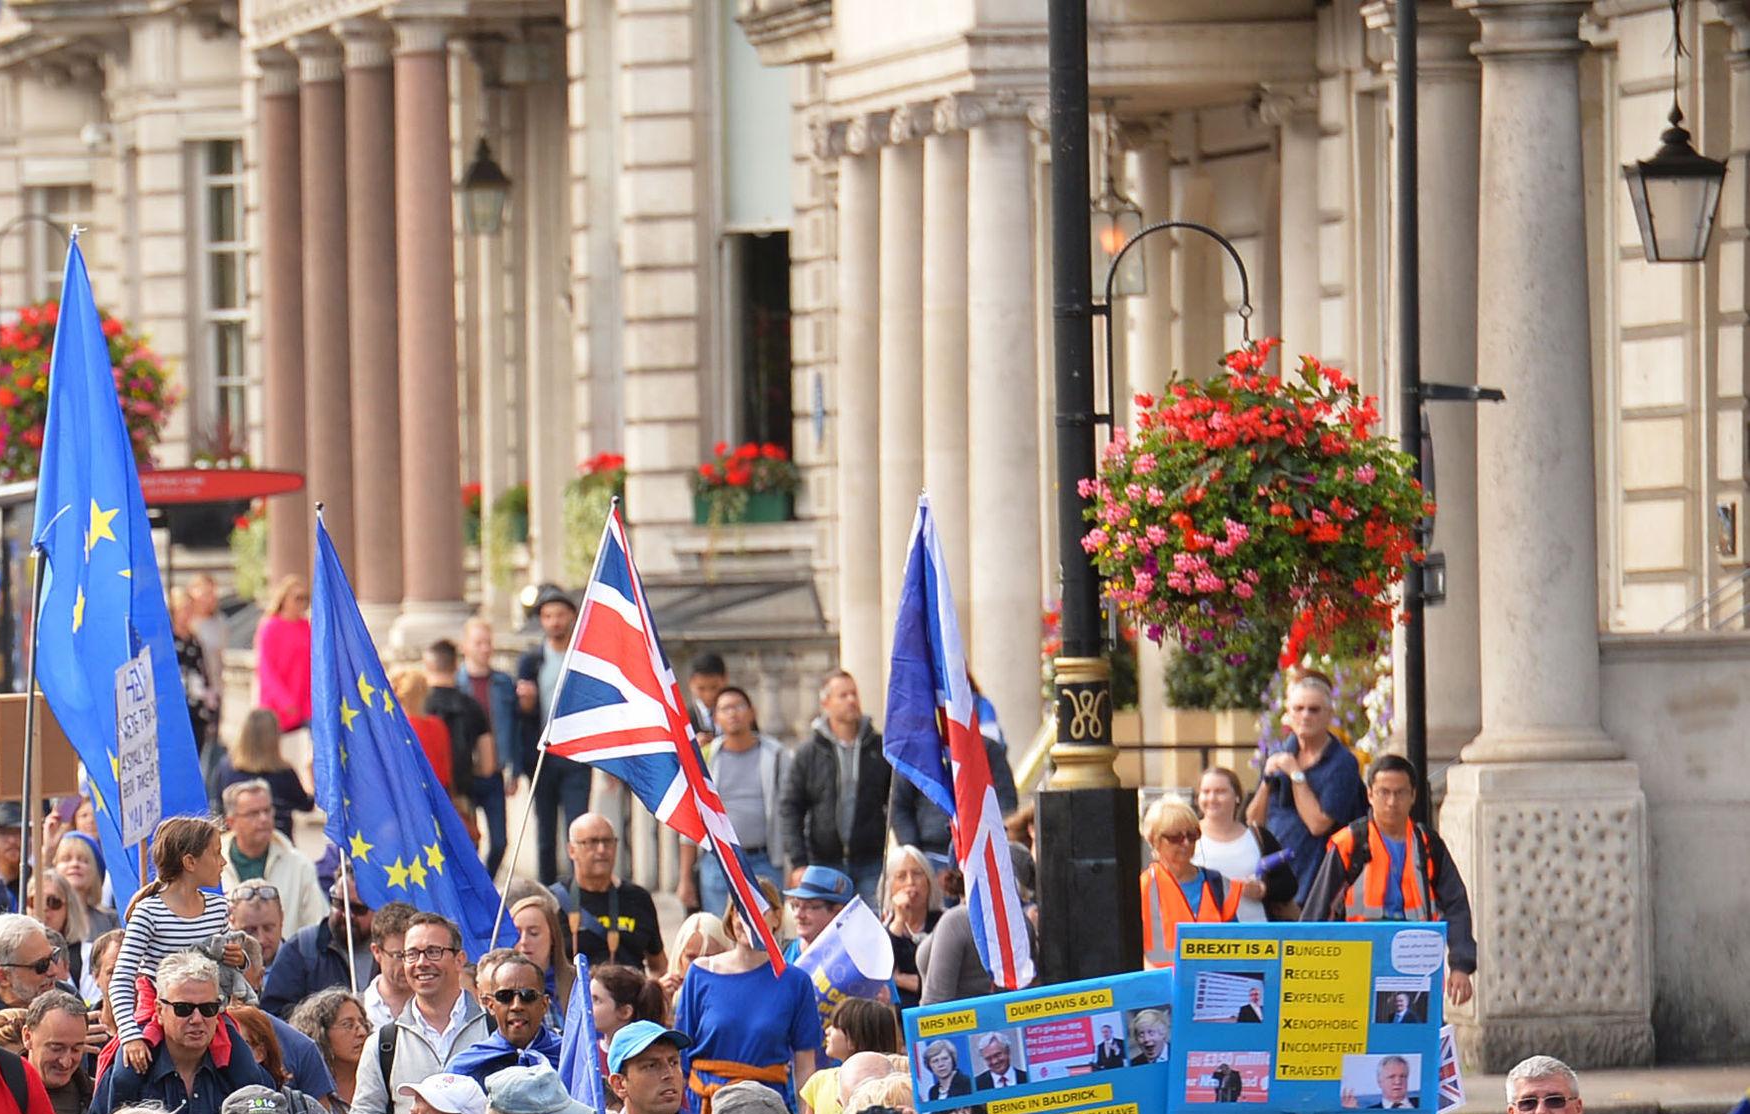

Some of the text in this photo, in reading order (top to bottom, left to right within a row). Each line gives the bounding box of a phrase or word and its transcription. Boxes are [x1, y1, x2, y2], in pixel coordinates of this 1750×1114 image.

[1186, 943, 1275, 955] BREXIT IS A
[1284, 945, 1341, 957] BUNGLED
[1284, 969, 1340, 980] RECKLESS
[1283, 993, 1345, 1004] EXPENSIVE
[1010, 1002, 1042, 1017] DUMP
[1045, 997, 1076, 1011] DAVIS
[1079, 996, 1088, 1006] &
[920, 1014, 974, 1031] MRS MAY.
[1282, 1018, 1359, 1030] XENOPHOBIC
[1281, 1041, 1363, 1053] INCOMPETENT
[1280, 1065, 1338, 1076] TRAVESTY
[992, 1089, 1098, 1114] BRING IN BALDRICK.
